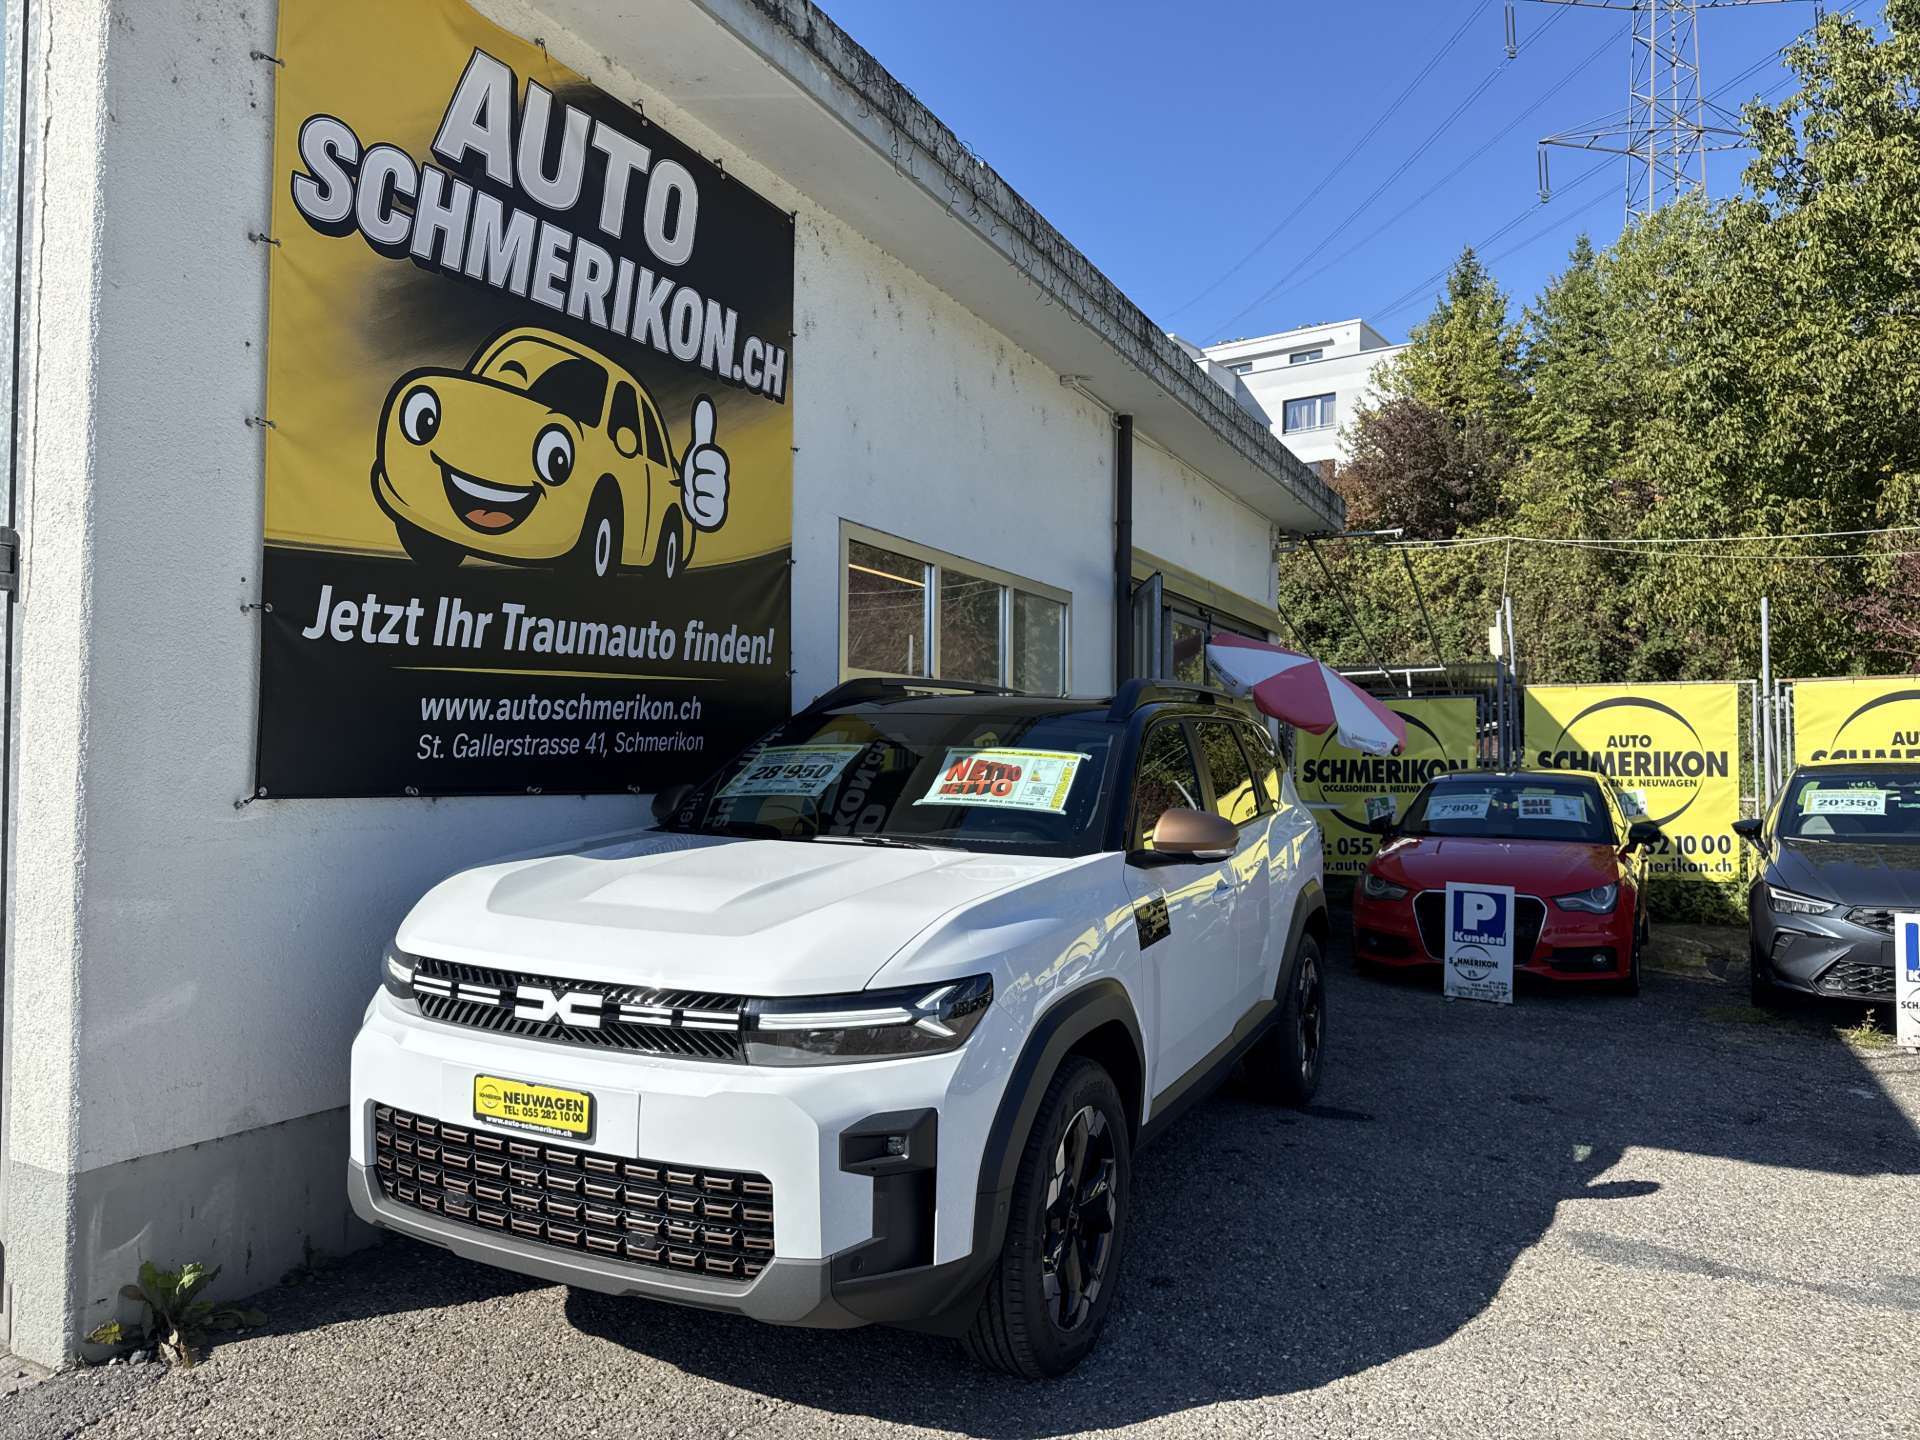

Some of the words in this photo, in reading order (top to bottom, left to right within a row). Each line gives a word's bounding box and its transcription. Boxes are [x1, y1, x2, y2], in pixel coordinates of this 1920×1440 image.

[432, 48, 700, 267] AUTO
[292, 116, 787, 400] SCHMERIKON.CH
[302, 585, 424, 647] Jetzt
[433, 597, 493, 650] Ihr
[501, 602, 677, 661] Traumauto
[684, 619, 775, 665] finden!
[420, 695, 702, 721] www.autoschmerikon.ch
[417, 734, 446, 760] St.
[452, 732, 580, 758] Gallerstrasse
[585, 732, 609, 760] 41,
[614, 731, 704, 754] Schmerikon
[1607, 735, 1652, 748] AUTO
[1891, 731, 1920, 746] AU
[749, 764, 834, 780] 28'950
[944, 757, 1022, 782] NETTO
[1537, 751, 1728, 777] SCHMERIKON
[938, 778, 1013, 796] NETTO
[1322, 784, 1377, 793] OCCASIONEN
[1380, 785, 1387, 793] &
[1627, 779, 1635, 787] &
[1639, 779, 1698, 787] NEUWAGEN
[1817, 799, 1878, 807] 20'350
[1337, 837, 1373, 855] 055
[1675, 835, 1697, 855] 10
[1701, 835, 1731, 855] 00
[1463, 892, 1497, 930] P
[1454, 931, 1505, 946] Kunden
[503, 1091, 584, 1113] NEUWAGEN
[504, 1105, 519, 1116] TEL:
[522, 1107, 539, 1118] 055
[541, 1109, 557, 1121] 282
[560, 1112, 571, 1121] 10
[572, 1113, 584, 1123] 00
[486, 1116, 573, 1137] www.auto-schmerikon.ch
